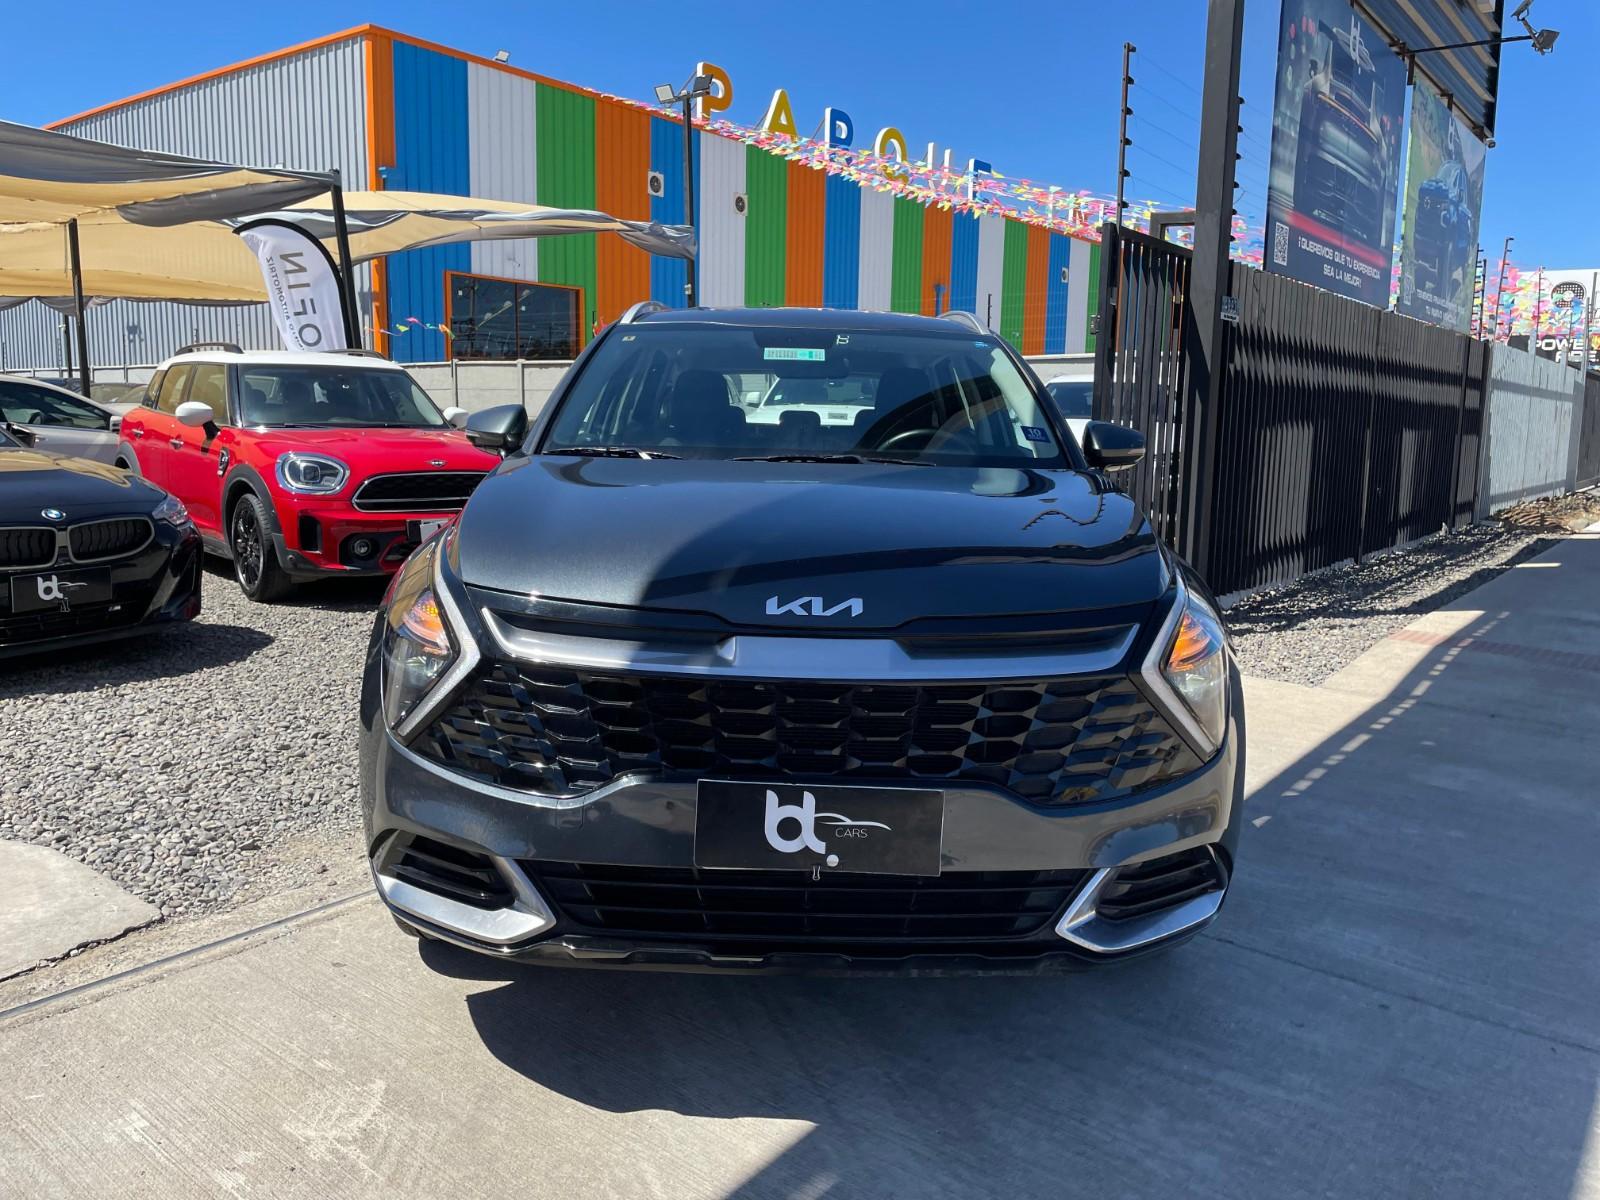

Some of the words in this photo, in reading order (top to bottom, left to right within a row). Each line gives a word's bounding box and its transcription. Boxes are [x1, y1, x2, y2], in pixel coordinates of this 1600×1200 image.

[1323, 263, 1335, 278] SEA
[1335, 268, 1343, 280] LA
[835, 828, 868, 839] CARS
